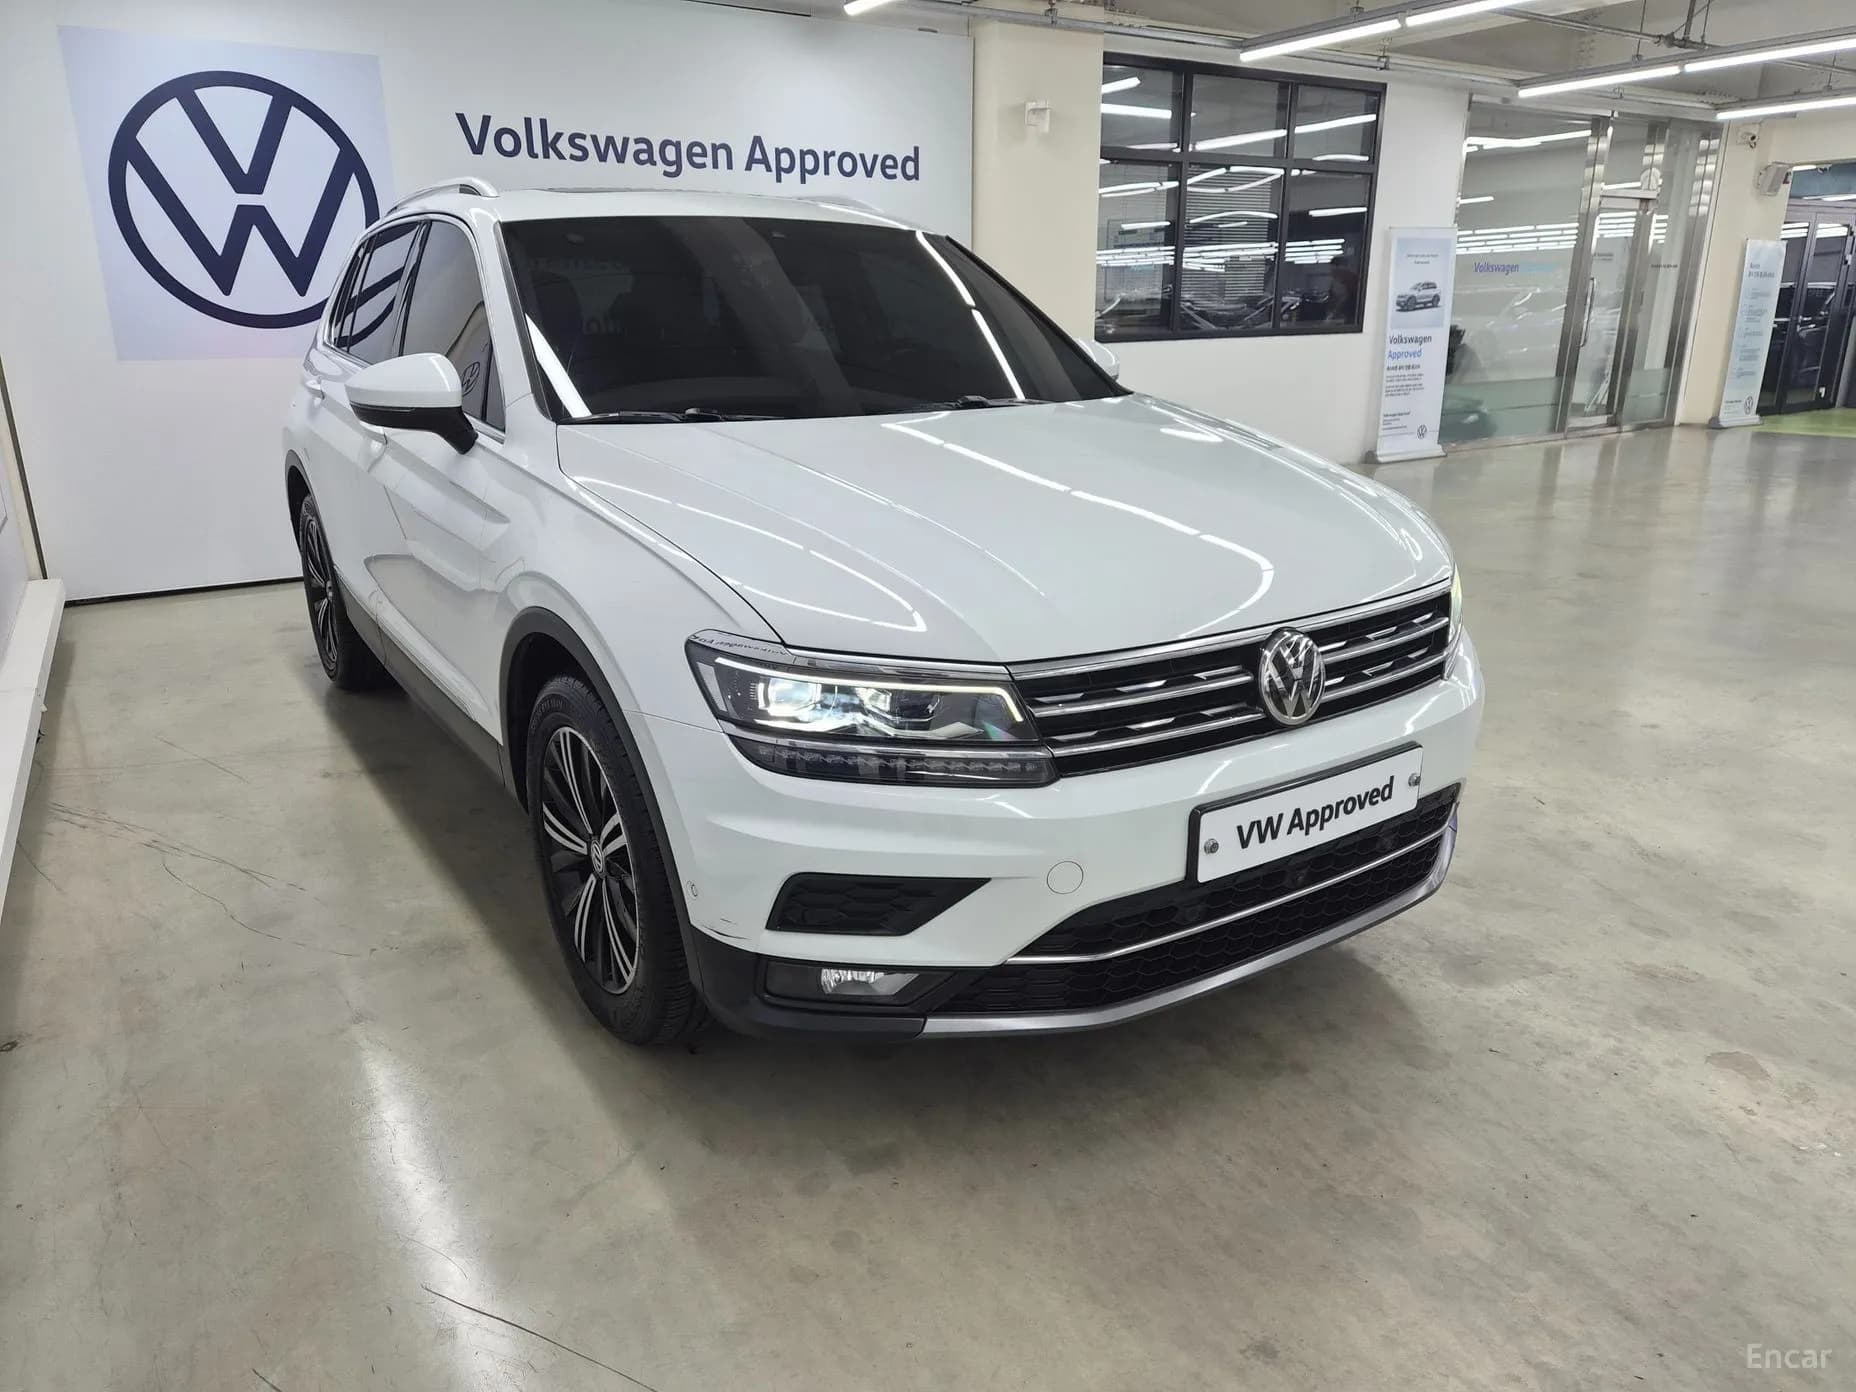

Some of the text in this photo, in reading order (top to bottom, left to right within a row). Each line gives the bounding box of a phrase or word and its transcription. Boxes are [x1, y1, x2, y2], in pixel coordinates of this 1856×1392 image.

[455, 112, 920, 184] Volkswagen Approved
[1474, 262, 1520, 276] Volkswagen
[1389, 335, 1432, 346] Volkswagen
[1388, 349, 1422, 360] Approved
[1236, 775, 1395, 849] VW Approved
